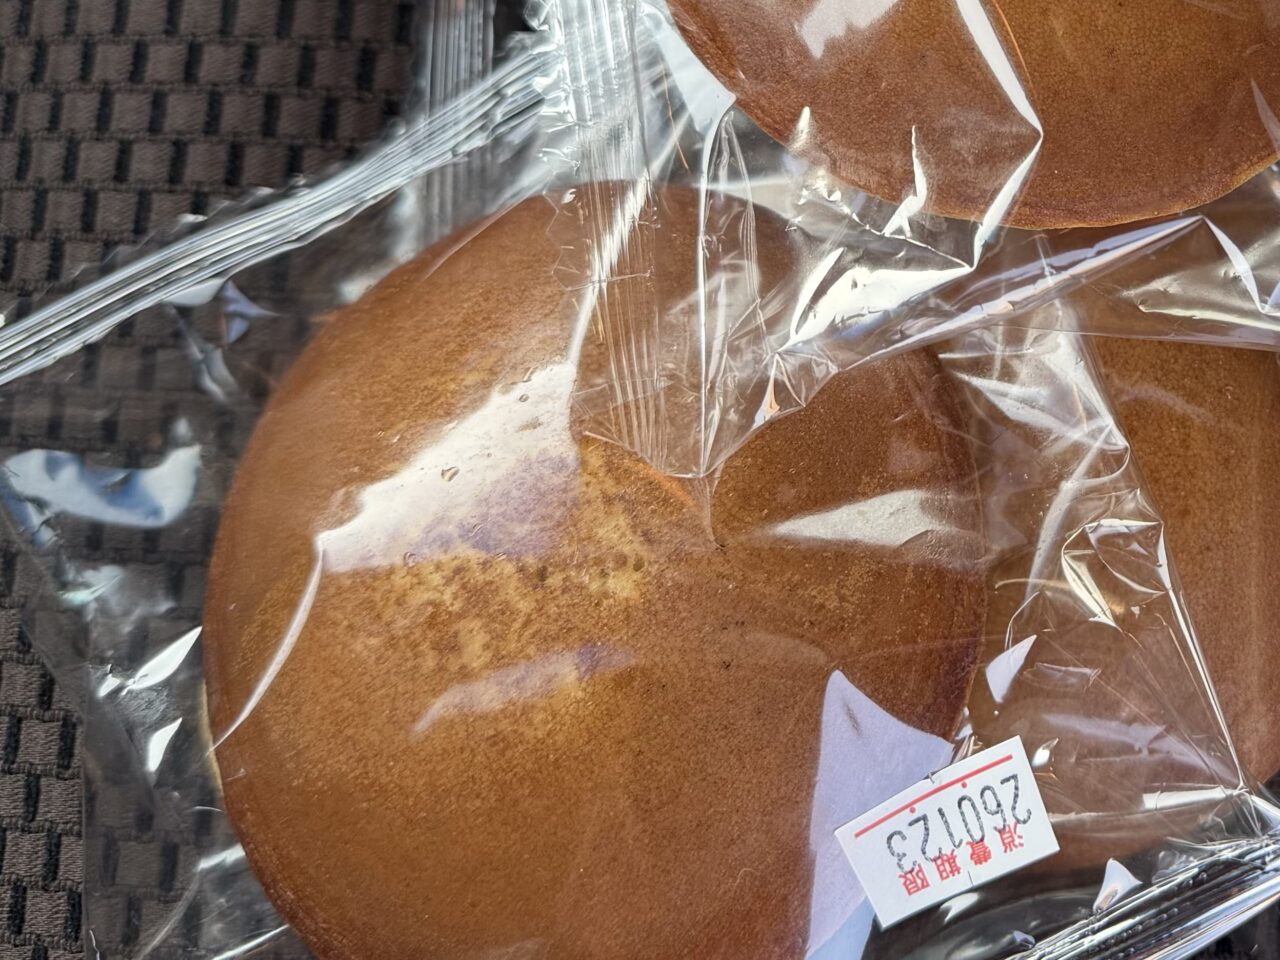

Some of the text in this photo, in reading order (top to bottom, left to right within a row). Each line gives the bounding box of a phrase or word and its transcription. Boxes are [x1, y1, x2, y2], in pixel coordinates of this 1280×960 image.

[886, 773, 1033, 875] 260123
[896, 822, 1025, 897] 消費期限
